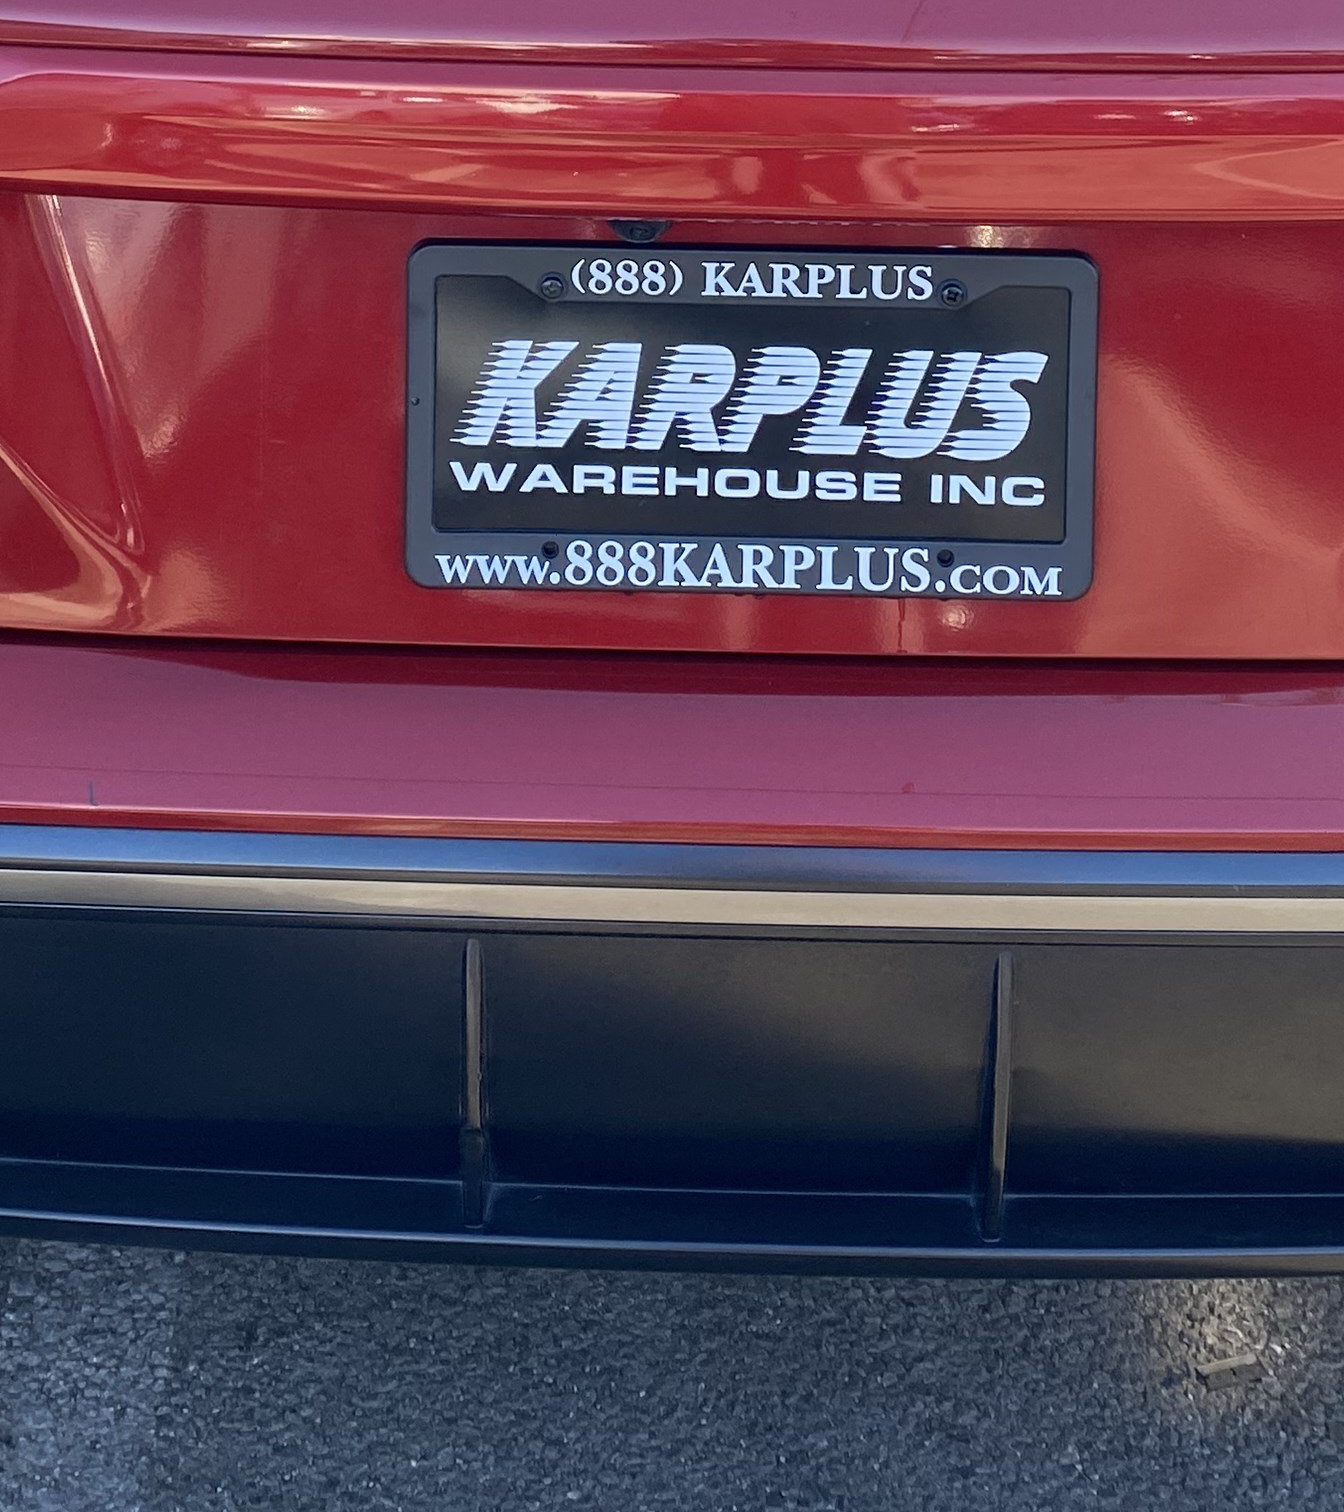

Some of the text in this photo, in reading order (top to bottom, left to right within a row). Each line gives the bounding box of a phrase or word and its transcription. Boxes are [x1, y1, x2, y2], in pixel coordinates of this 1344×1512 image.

[570, 257, 934, 301] (888) KARPLUS
[448, 338, 1050, 462] KARPLUS
[449, 461, 1046, 507] WAREHOUSE INC
